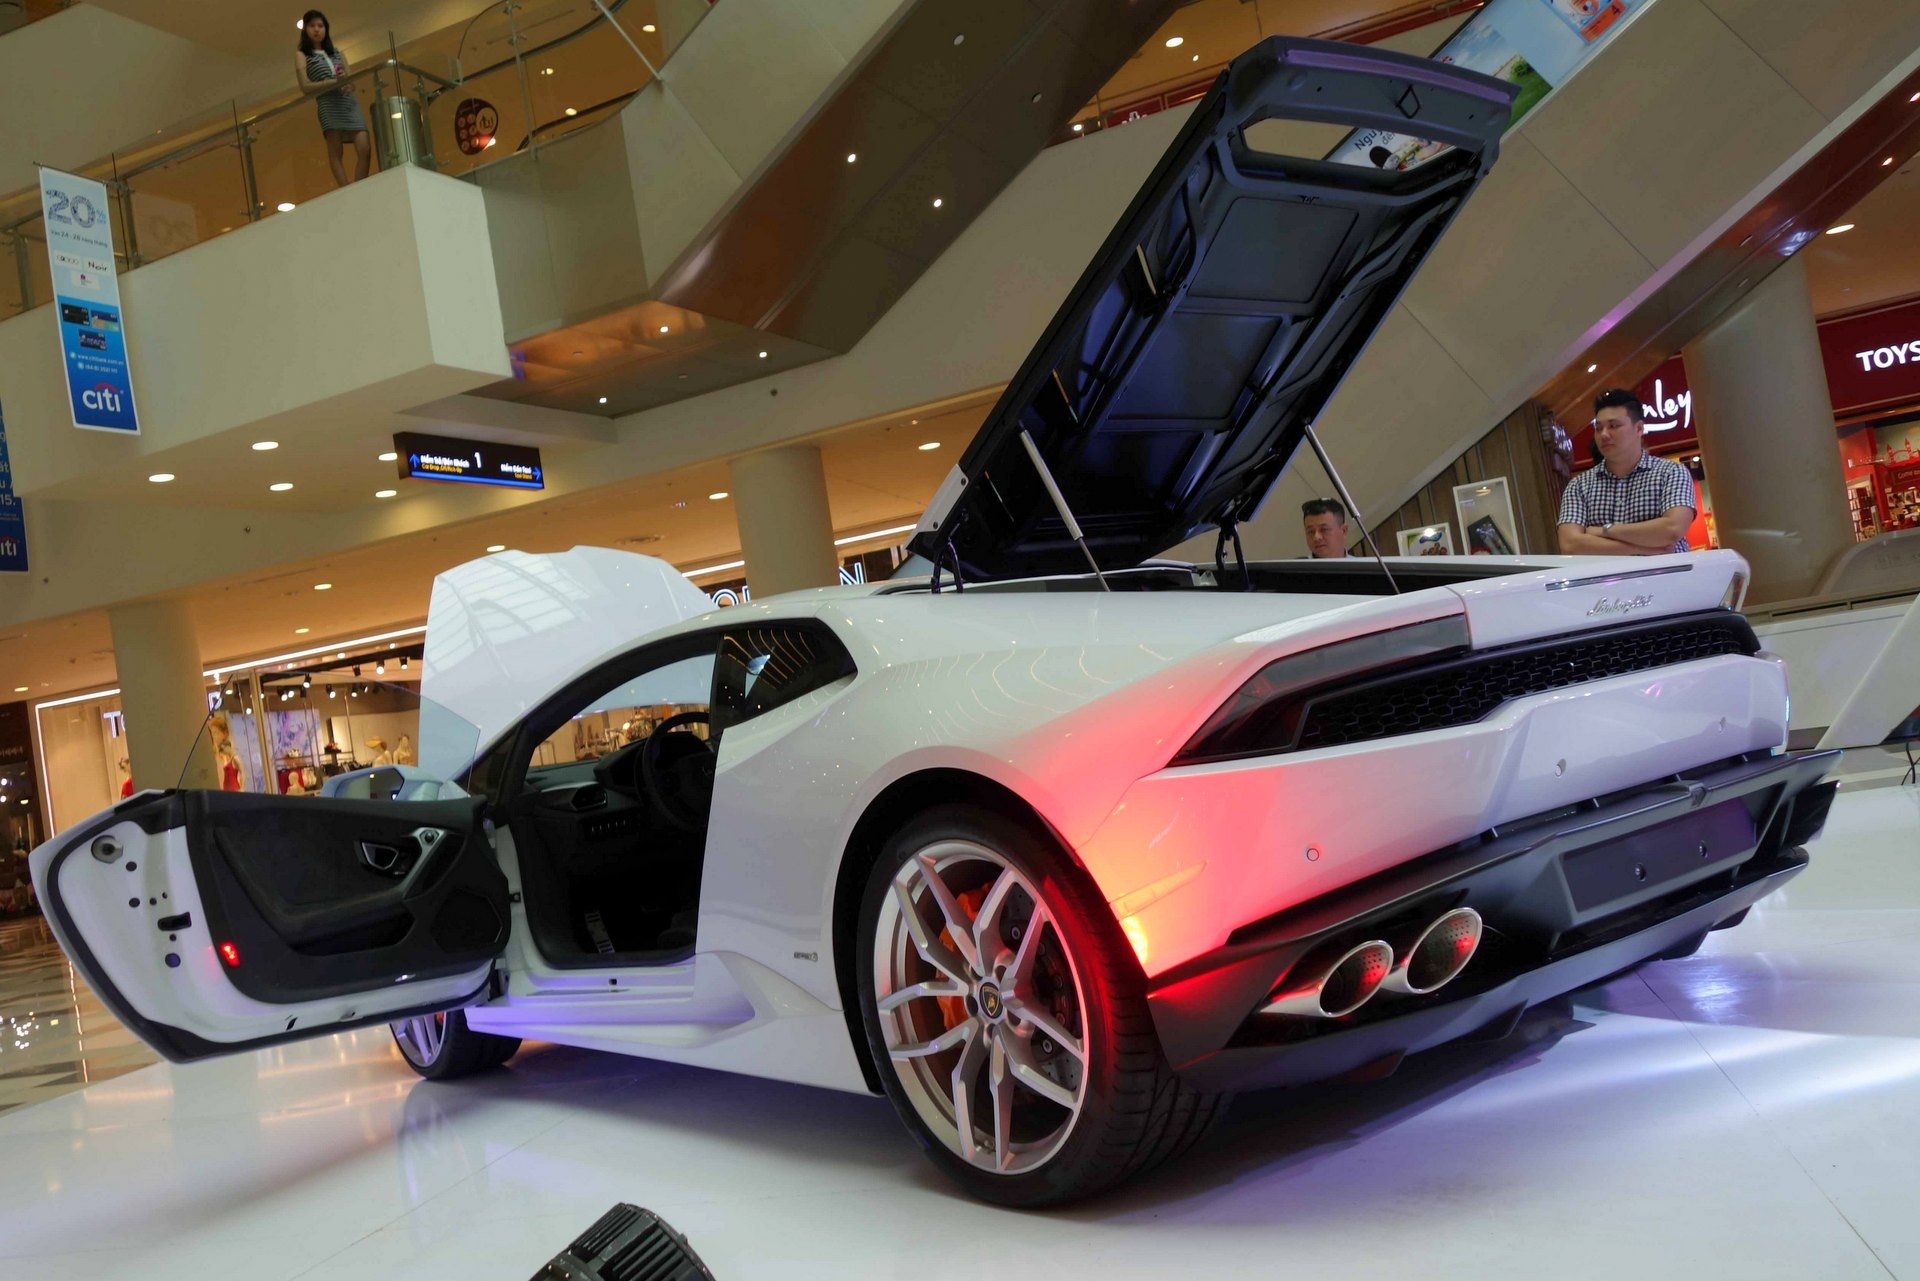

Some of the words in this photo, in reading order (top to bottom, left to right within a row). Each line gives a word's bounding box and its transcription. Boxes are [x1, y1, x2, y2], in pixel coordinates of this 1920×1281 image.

[1354, 129, 1385, 150] Ngu
[1856, 340, 1920, 371] TOYS
[82, 386, 121, 413] citi
[474, 452, 482, 468] 1
[0, 539, 17, 557] iti
